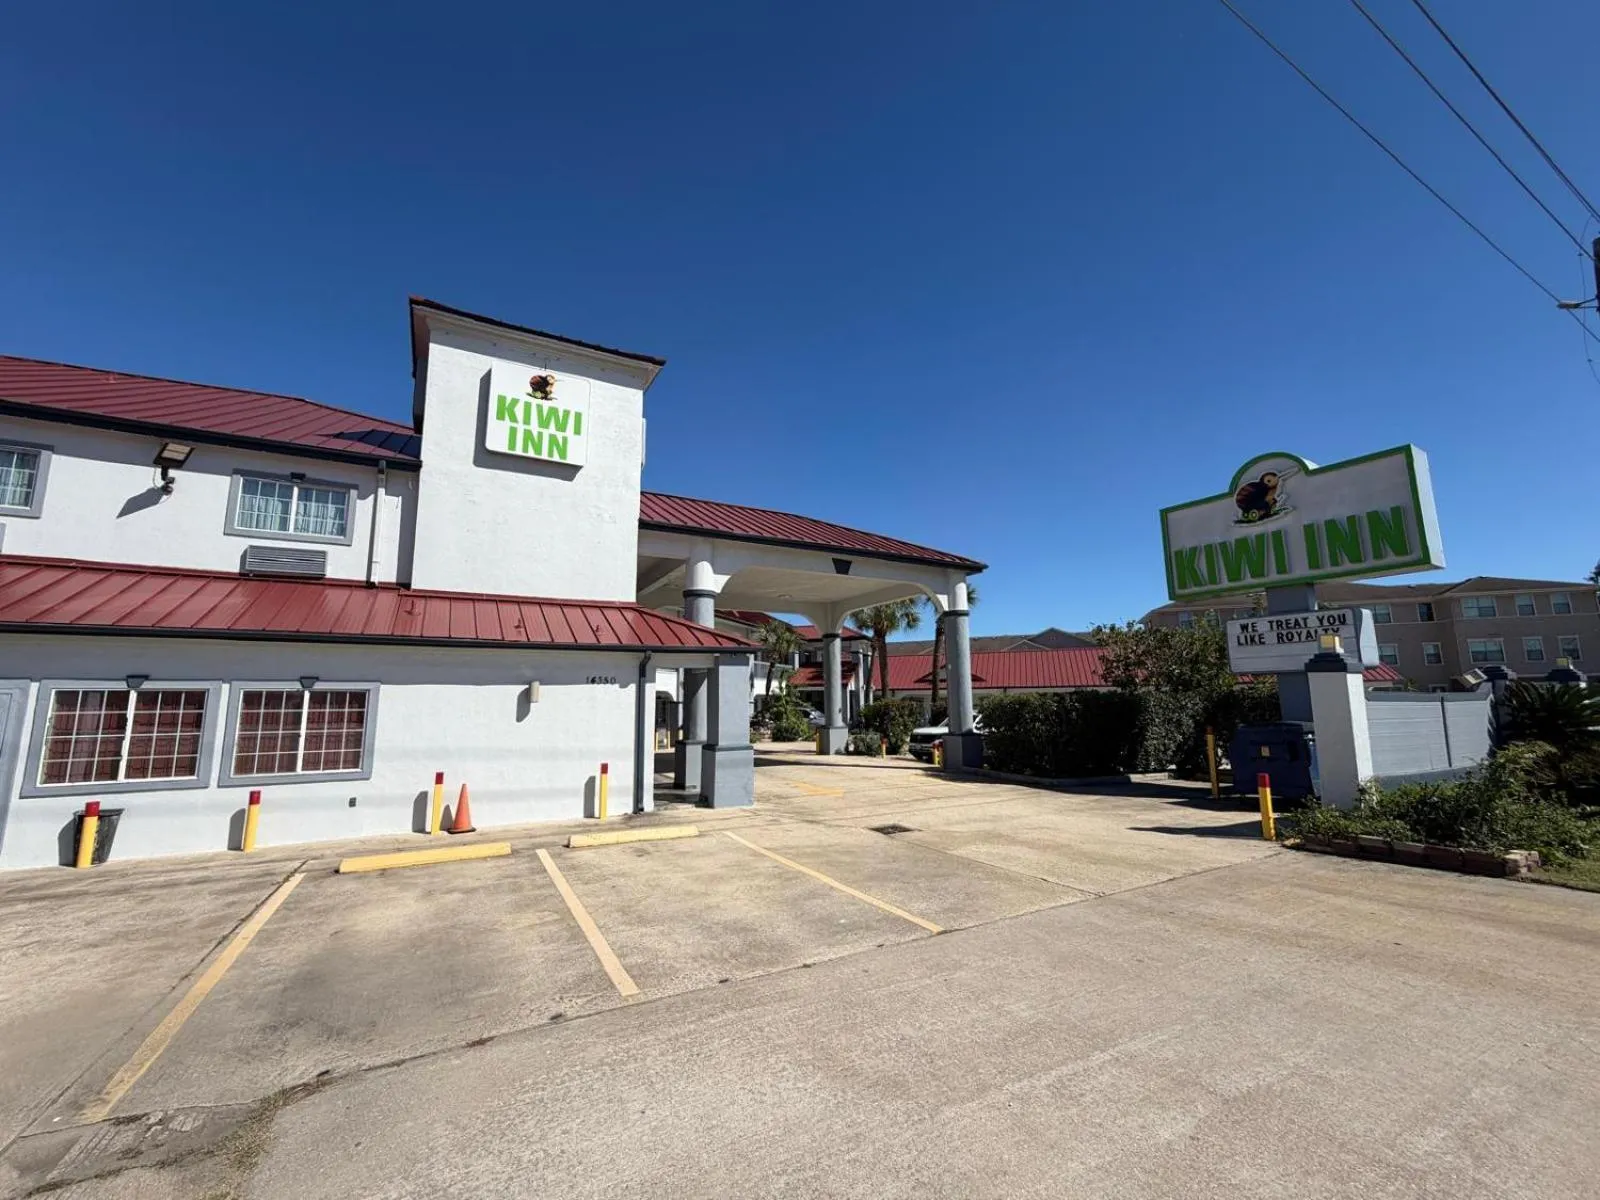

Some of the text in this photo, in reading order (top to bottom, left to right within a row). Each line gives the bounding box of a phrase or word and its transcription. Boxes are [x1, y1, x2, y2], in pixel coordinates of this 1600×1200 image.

[496, 394, 582, 436] KIWI
[507, 425, 568, 460] INN
[1174, 505, 1410, 590] KIWI INN
[1237, 633, 1266, 646] LIKE
[1240, 613, 1347, 634] WE TREAT YOU
